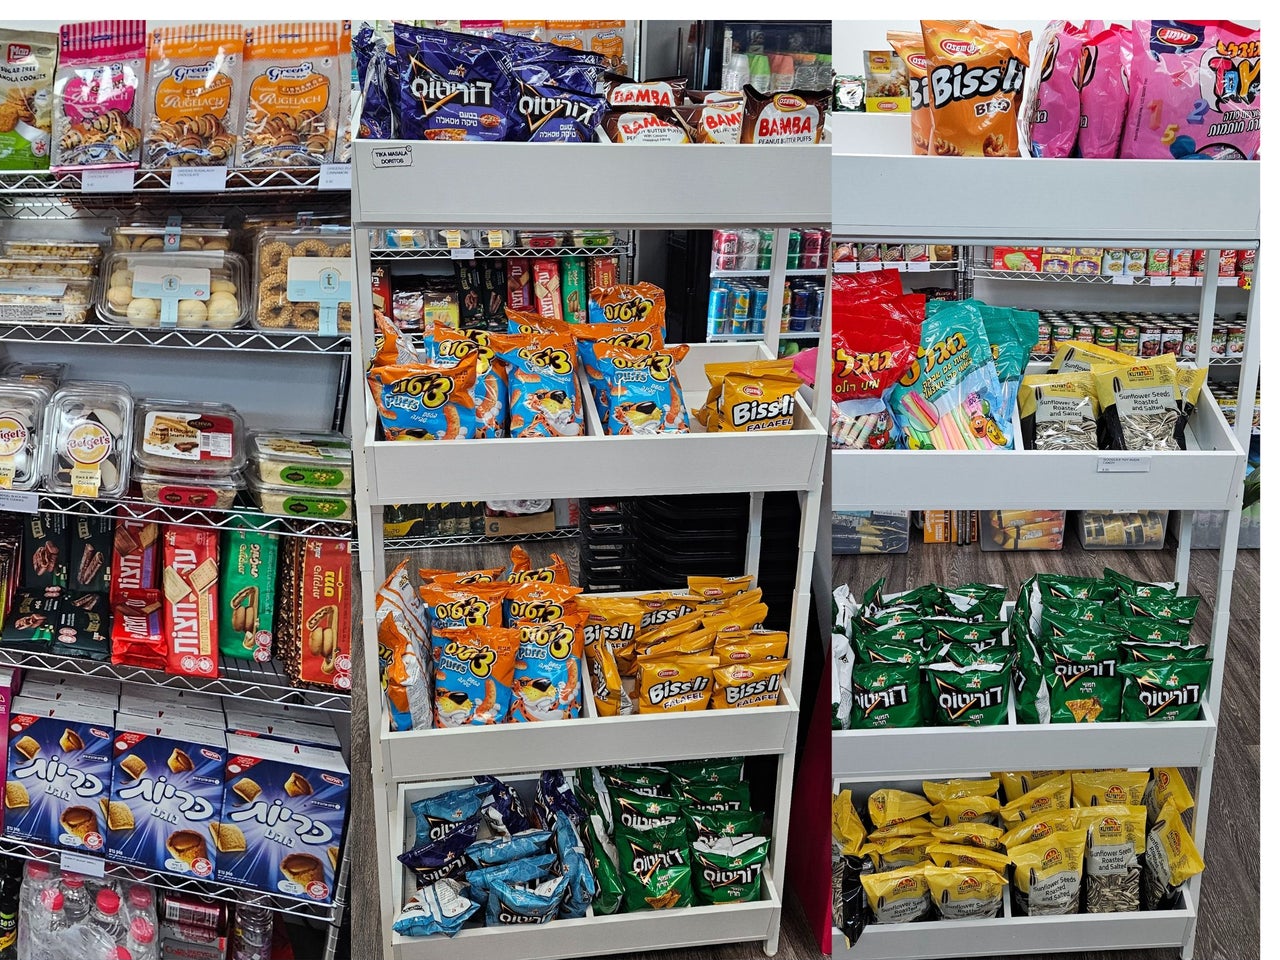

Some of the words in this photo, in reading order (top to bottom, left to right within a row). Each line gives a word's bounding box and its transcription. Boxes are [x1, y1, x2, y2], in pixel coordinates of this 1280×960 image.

[410, 77, 492, 105] דוריטוס
[932, 58, 1026, 106] Bissli
[613, 90, 671, 107] BAMBA
[975, 99, 1010, 117] BBQ
[759, 117, 812, 133] BAMBA
[1153, 390, 1170, 398] Seeds
[1055, 660, 1116, 679] דוריטוס
[649, 674, 708, 697] Bissli
